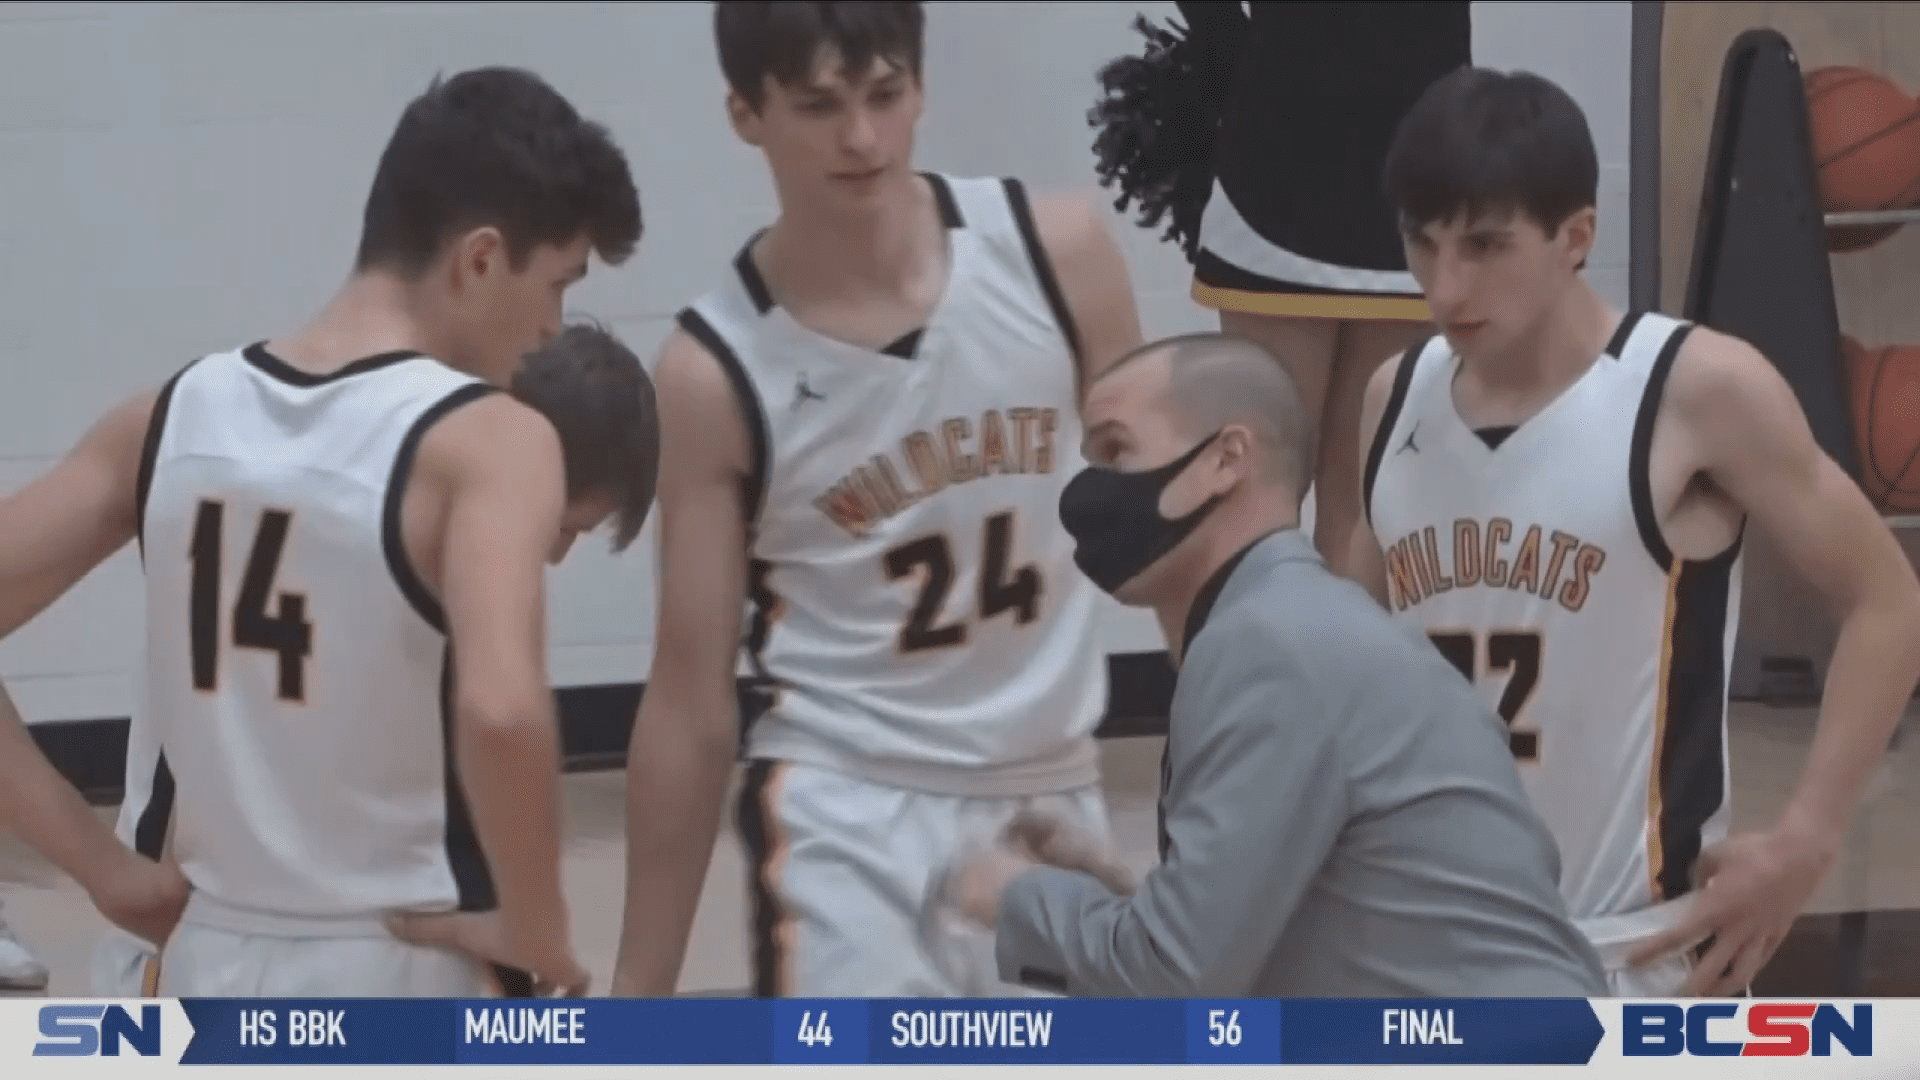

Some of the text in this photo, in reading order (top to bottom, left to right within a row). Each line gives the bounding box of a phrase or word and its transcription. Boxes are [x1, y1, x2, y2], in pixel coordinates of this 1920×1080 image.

[812, 406, 1058, 539] WILDCATS
[188, 498, 312, 704] 14
[882, 507, 1042, 653] 24
[1387, 517, 1606, 612] WILDCATS
